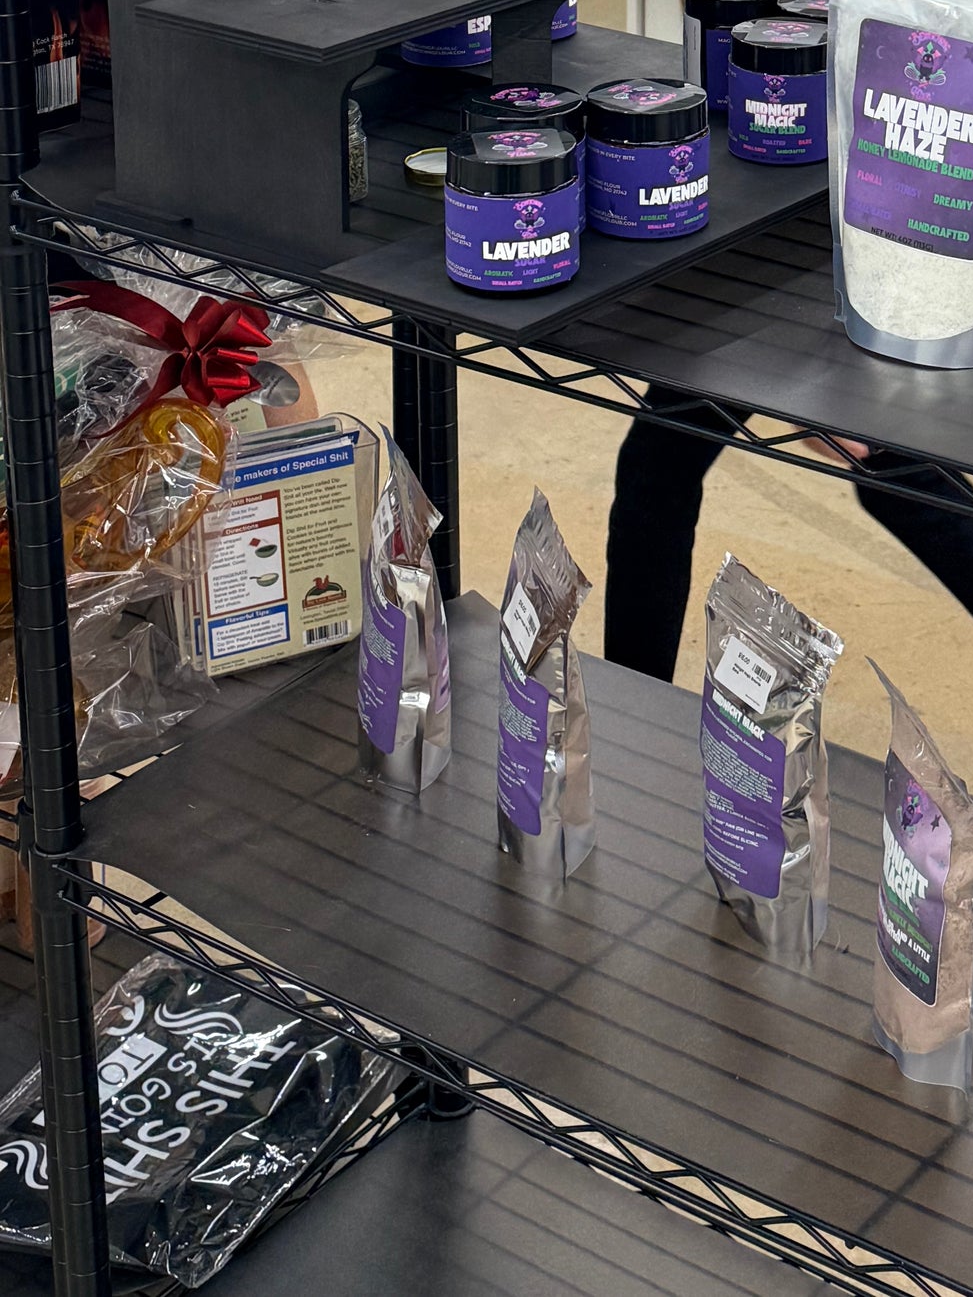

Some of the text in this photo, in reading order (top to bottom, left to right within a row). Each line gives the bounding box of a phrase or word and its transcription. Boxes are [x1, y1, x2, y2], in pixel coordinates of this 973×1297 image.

[745, 99, 807, 117] MIDNIGHT
[749, 122, 806, 134] SUGAR BLEND
[754, 114, 796, 128] MAGIC
[884, 122, 947, 164] HAZE
[606, 152, 621, 160] EVERY
[857, 138, 885, 157] HONEY
[888, 148, 940, 172] LEMONADE
[857, 169, 882, 186] FLORAL
[639, 174, 709, 206] LAVENDER
[466, 204, 479, 212] BITE
[933, 193, 973, 211] DREAMY
[870, 227, 883, 238] NET
[907, 218, 970, 242] HANDCRAFTED
[482, 231, 571, 261] LAVENDER
[514, 257, 546, 268] SUGAR
[484, 268, 539, 277] AROMATIC LIGHT
[243, 451, 349, 482] makers of Special Shit
[246, 495, 263, 503] Need
[226, 523, 259, 534] Directions
[226, 613, 254, 624] Flavorful
[908, 937, 913, 948] A
[913, 943, 931, 963] LITTLE
[167, 1036, 217, 1078] IS
[175, 1040, 298, 1116] THIS
